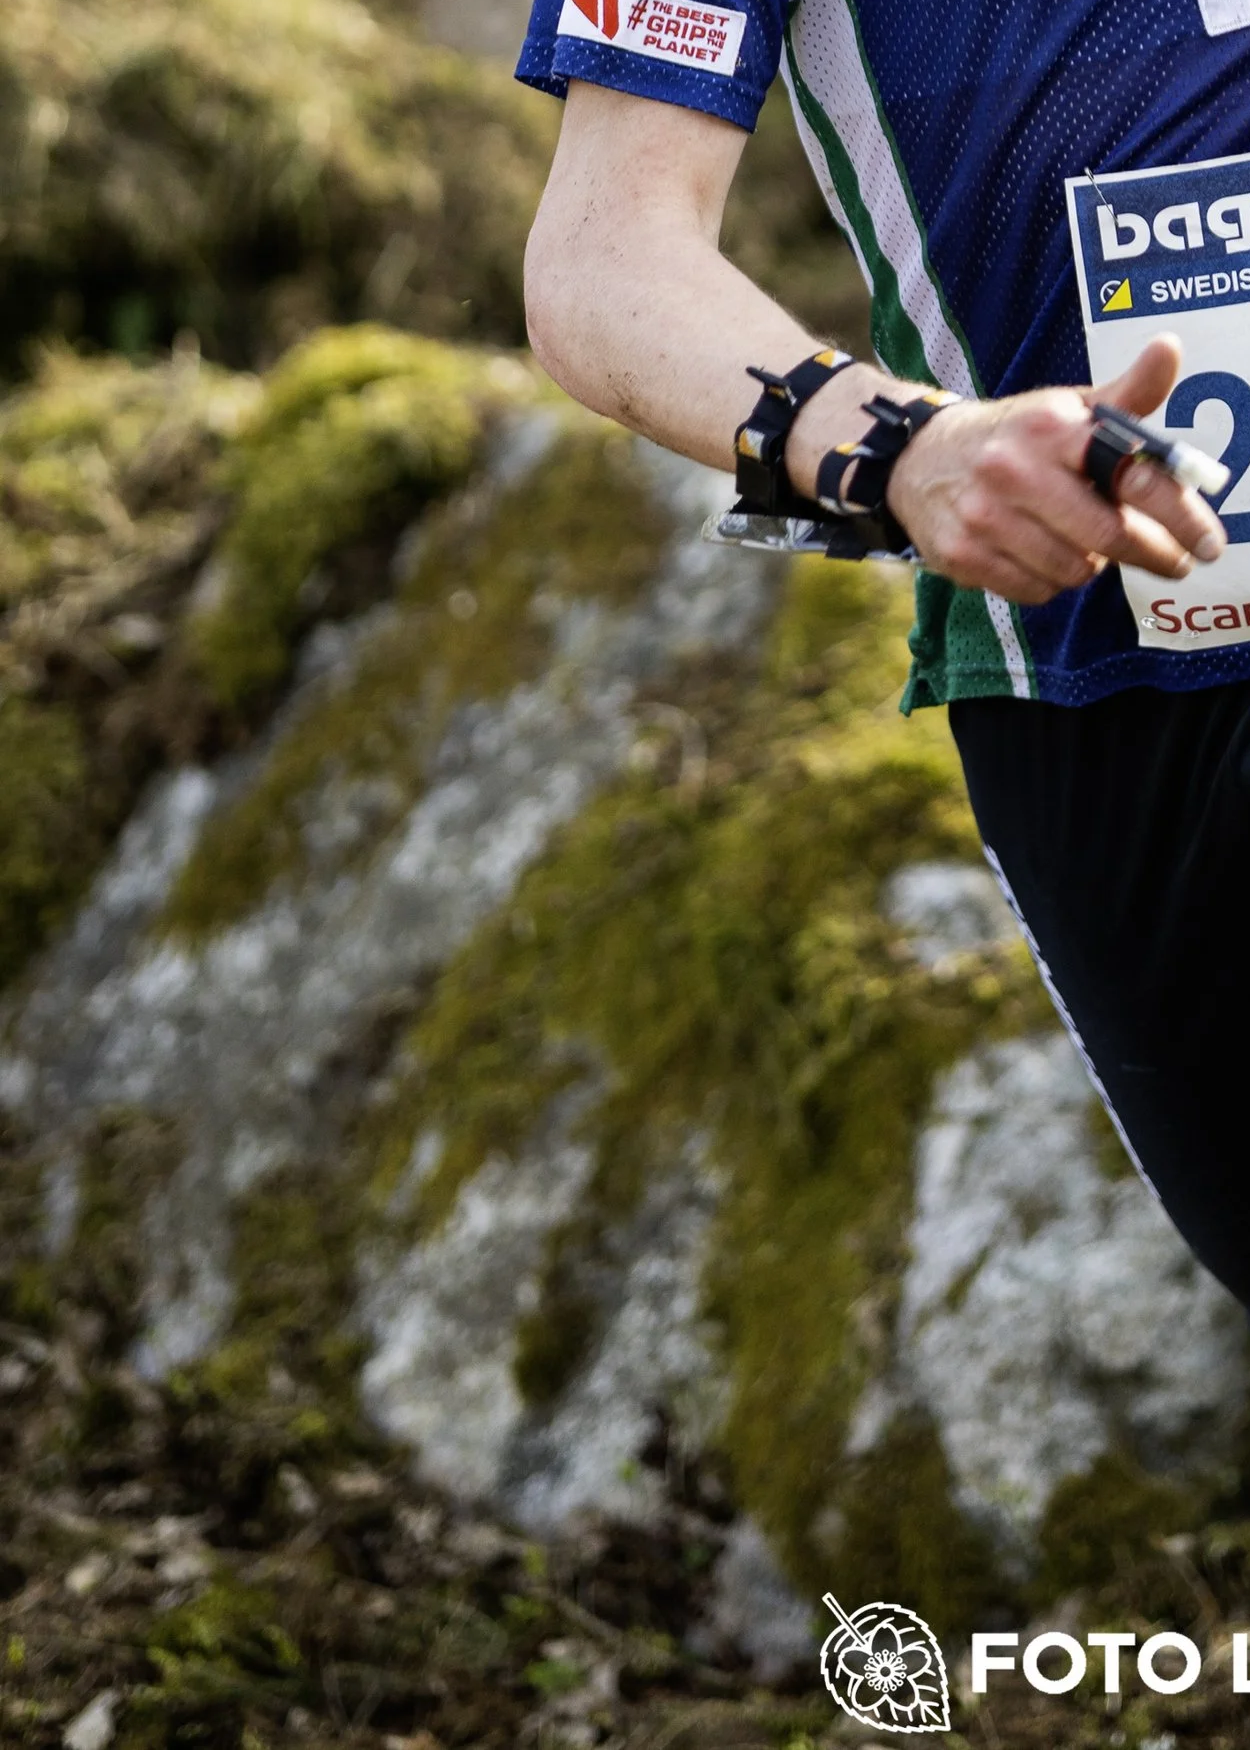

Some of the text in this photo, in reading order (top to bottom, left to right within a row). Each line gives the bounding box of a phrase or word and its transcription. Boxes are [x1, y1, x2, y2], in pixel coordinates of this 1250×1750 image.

[647, 15, 727, 41] GRIP ON
[676, 6, 729, 27] BEST
[643, 35, 721, 62] PLANET
